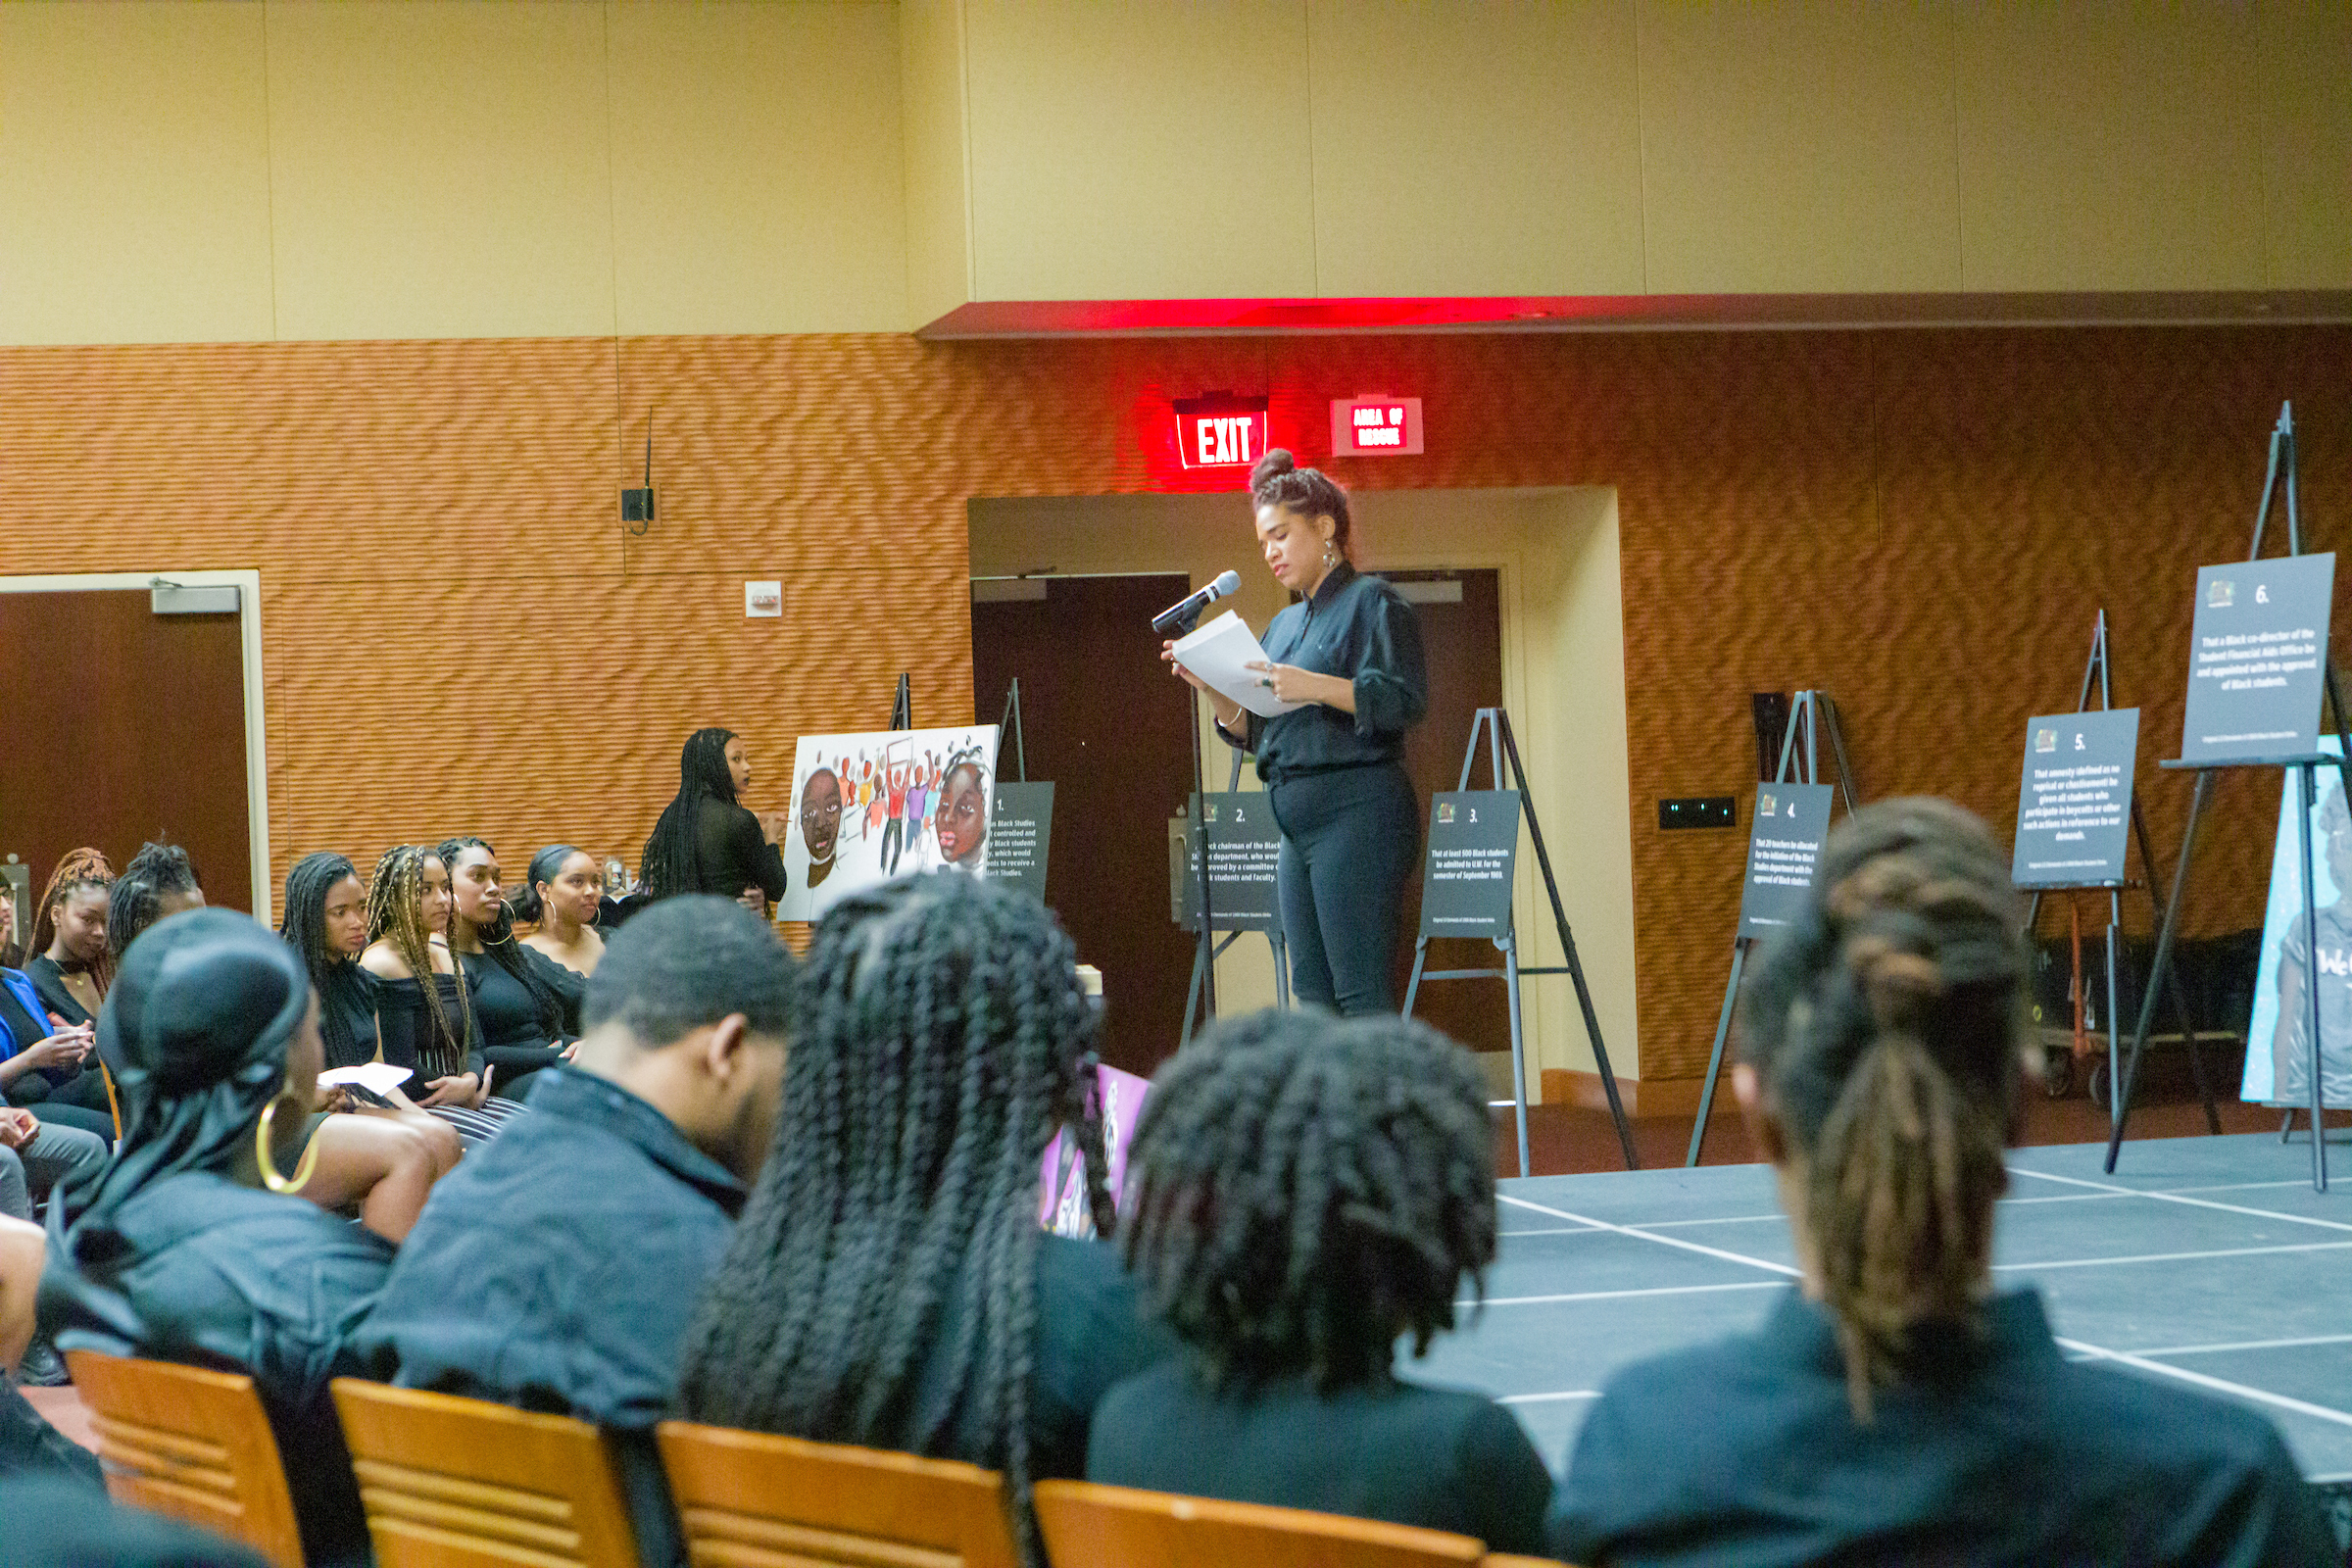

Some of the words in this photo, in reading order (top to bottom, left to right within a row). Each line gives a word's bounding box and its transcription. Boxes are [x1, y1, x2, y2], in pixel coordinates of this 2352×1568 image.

[1197, 417, 1251, 464] EXIT
[2255, 585, 2269, 604] 6.
[2075, 734, 2085, 750] 5.
[997, 799, 1004, 811] 1.
[1236, 808, 1245, 822] 2.
[1470, 808, 1478, 823] 3.
[1014, 819, 1035, 827] Studies
[1245, 841, 1253, 850] of
[1250, 852, 1264, 860] who
[1264, 852, 1279, 860] woul
[1432, 849, 1442, 858] That
[1449, 849, 1461, 858] least
[1473, 849, 1486, 858] Black
[1487, 848, 1509, 857] students
[1191, 863, 1199, 871] be
[1228, 863, 1237, 872] by
[1242, 862, 1274, 871] committee
[1436, 860, 1443, 869] be
[1443, 860, 1465, 868] admitted
[1466, 860, 1471, 868] to
[1483, 859, 1492, 868] for
[1492, 859, 1501, 868] the
[1433, 872, 1456, 880] semester
[1456, 871, 1462, 879] of
[1463, 871, 1490, 881] September
[2316, 949, 2352, 976] We
